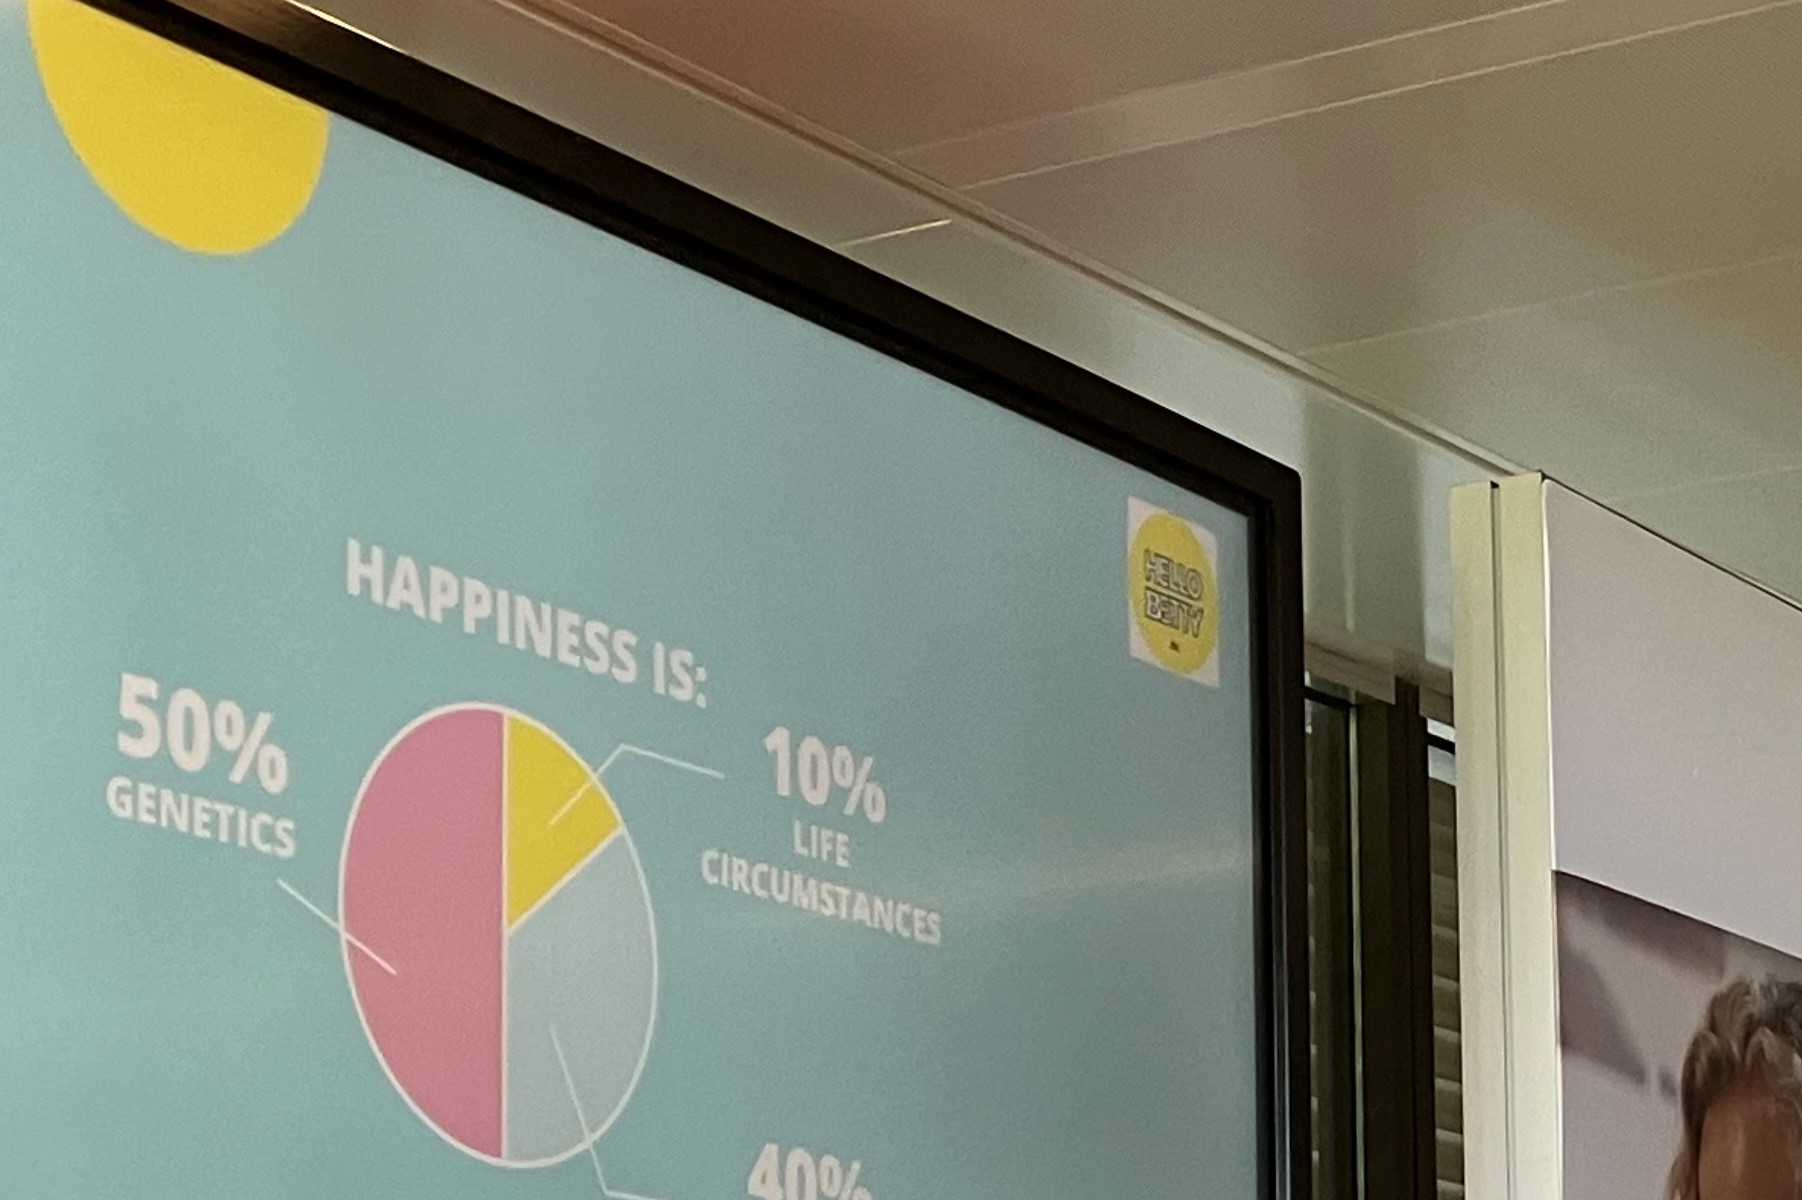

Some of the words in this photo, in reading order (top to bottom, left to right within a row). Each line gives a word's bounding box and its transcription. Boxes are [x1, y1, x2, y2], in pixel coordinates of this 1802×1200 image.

[346, 536, 638, 683] HAPPINESS
[652, 641, 707, 709] IS:
[118, 672, 289, 795] 50%
[763, 726, 886, 823] 10%
[106, 776, 296, 858] GENETICS
[794, 819, 850, 868] LIFE
[701, 850, 942, 945] CIRCUMSTANCES
